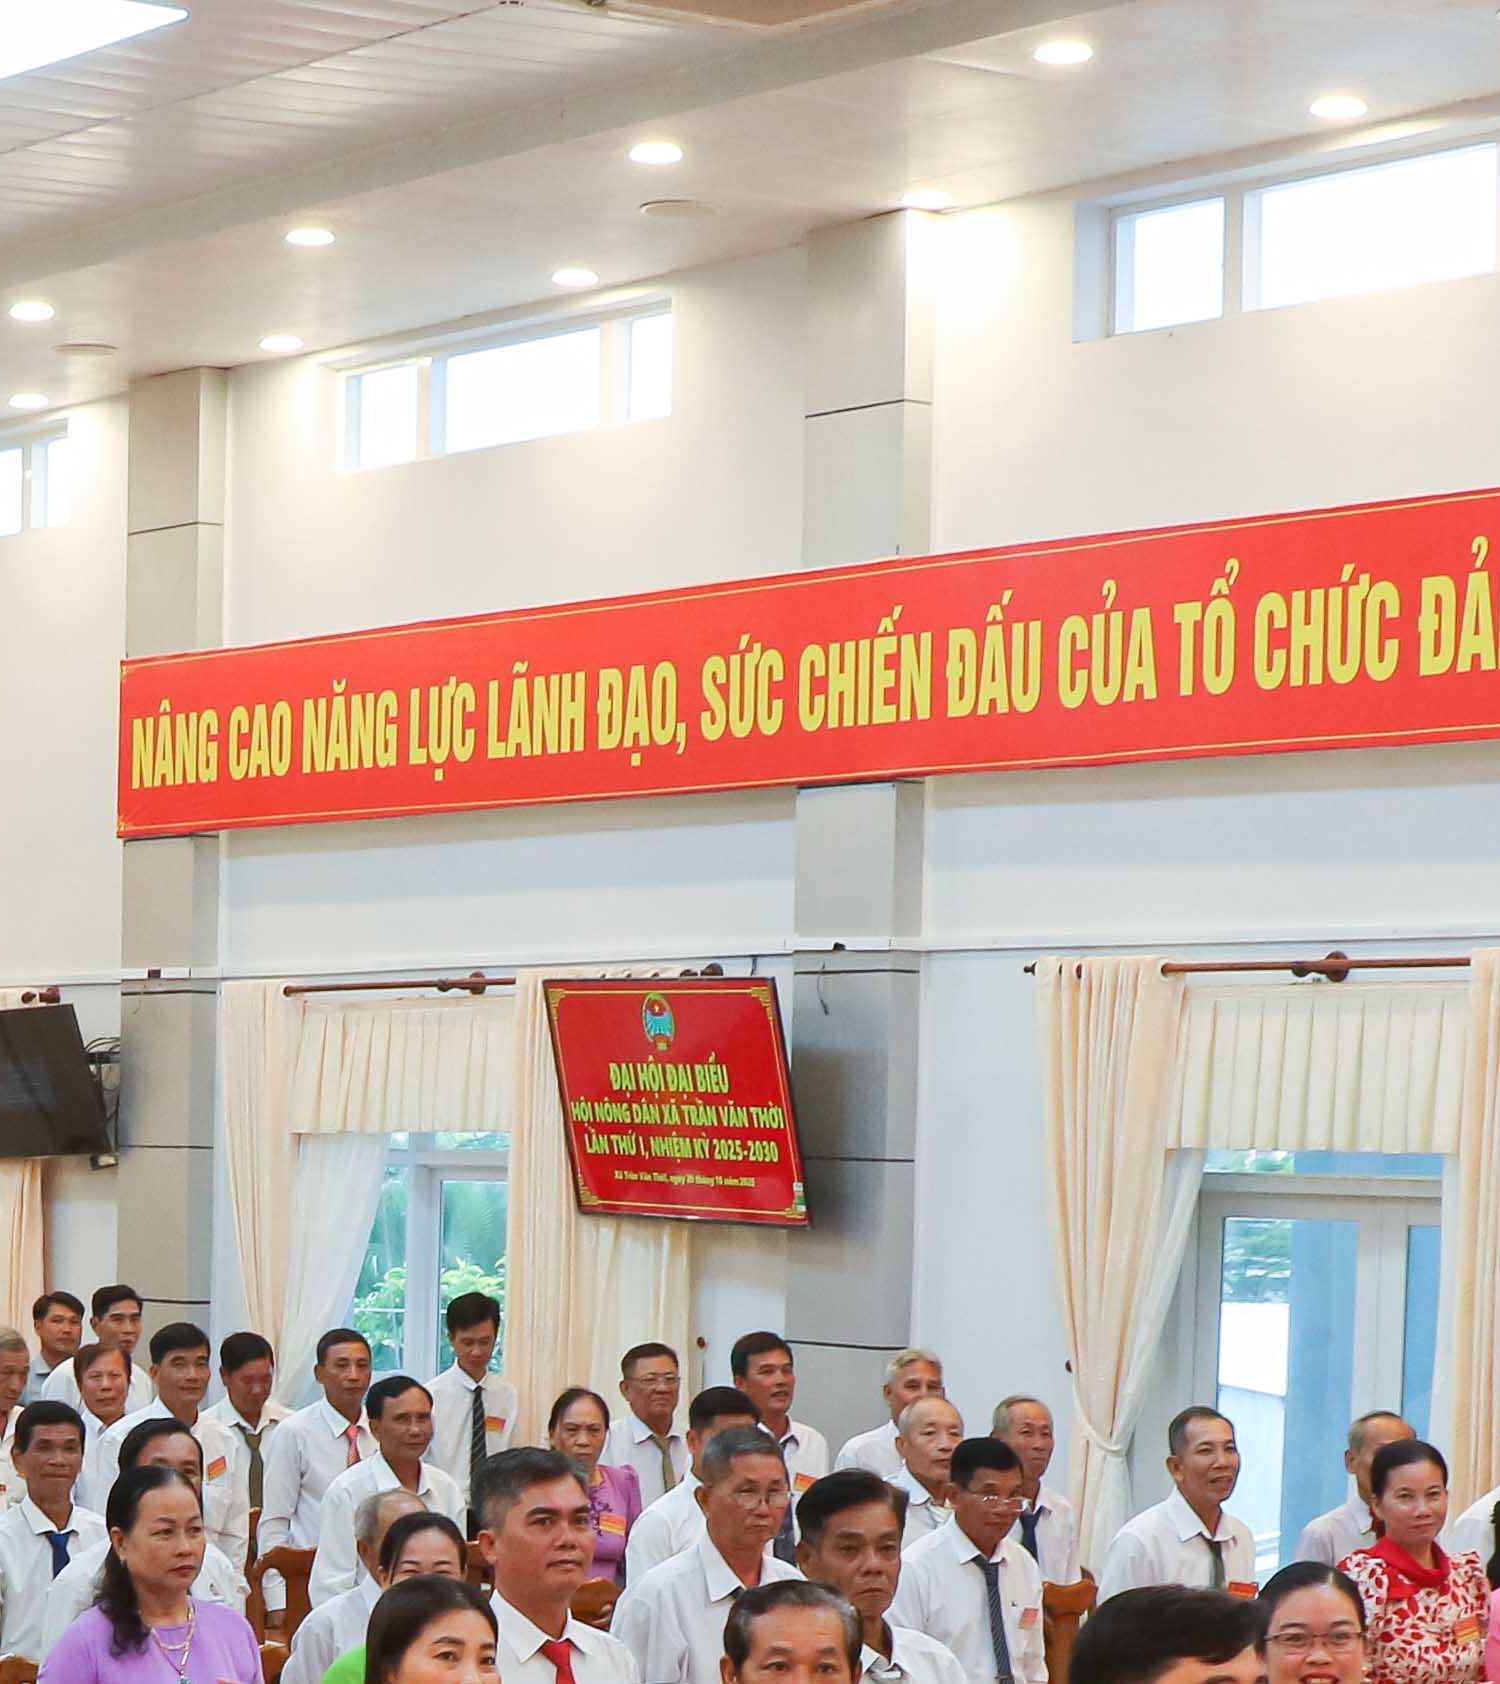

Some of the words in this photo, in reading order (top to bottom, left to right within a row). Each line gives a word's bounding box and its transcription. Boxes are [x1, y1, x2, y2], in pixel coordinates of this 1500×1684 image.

[132, 699, 218, 789] NÂNG
[229, 701, 292, 780] CAO
[302, 678, 398, 773] NĂNG
[409, 676, 475, 781] LỰC
[488, 661, 585, 759] LÃNH
[597, 661, 686, 766] ĐẠO,
[701, 633, 784, 741] SỨC
[799, 605, 932, 732] CHIẾN
[946, 589, 1042, 717] ĐẤU
[1058, 579, 1157, 709] CỦA
[1174, 558, 1239, 696] TỔ
[1254, 563, 1400, 690] CHỨC
[609, 1062, 636, 1099] ĐẠI
[639, 1056, 665, 1099] HỘI
[666, 1063, 692, 1100] ĐẠI
[695, 1051, 729, 1094] BIỂU
